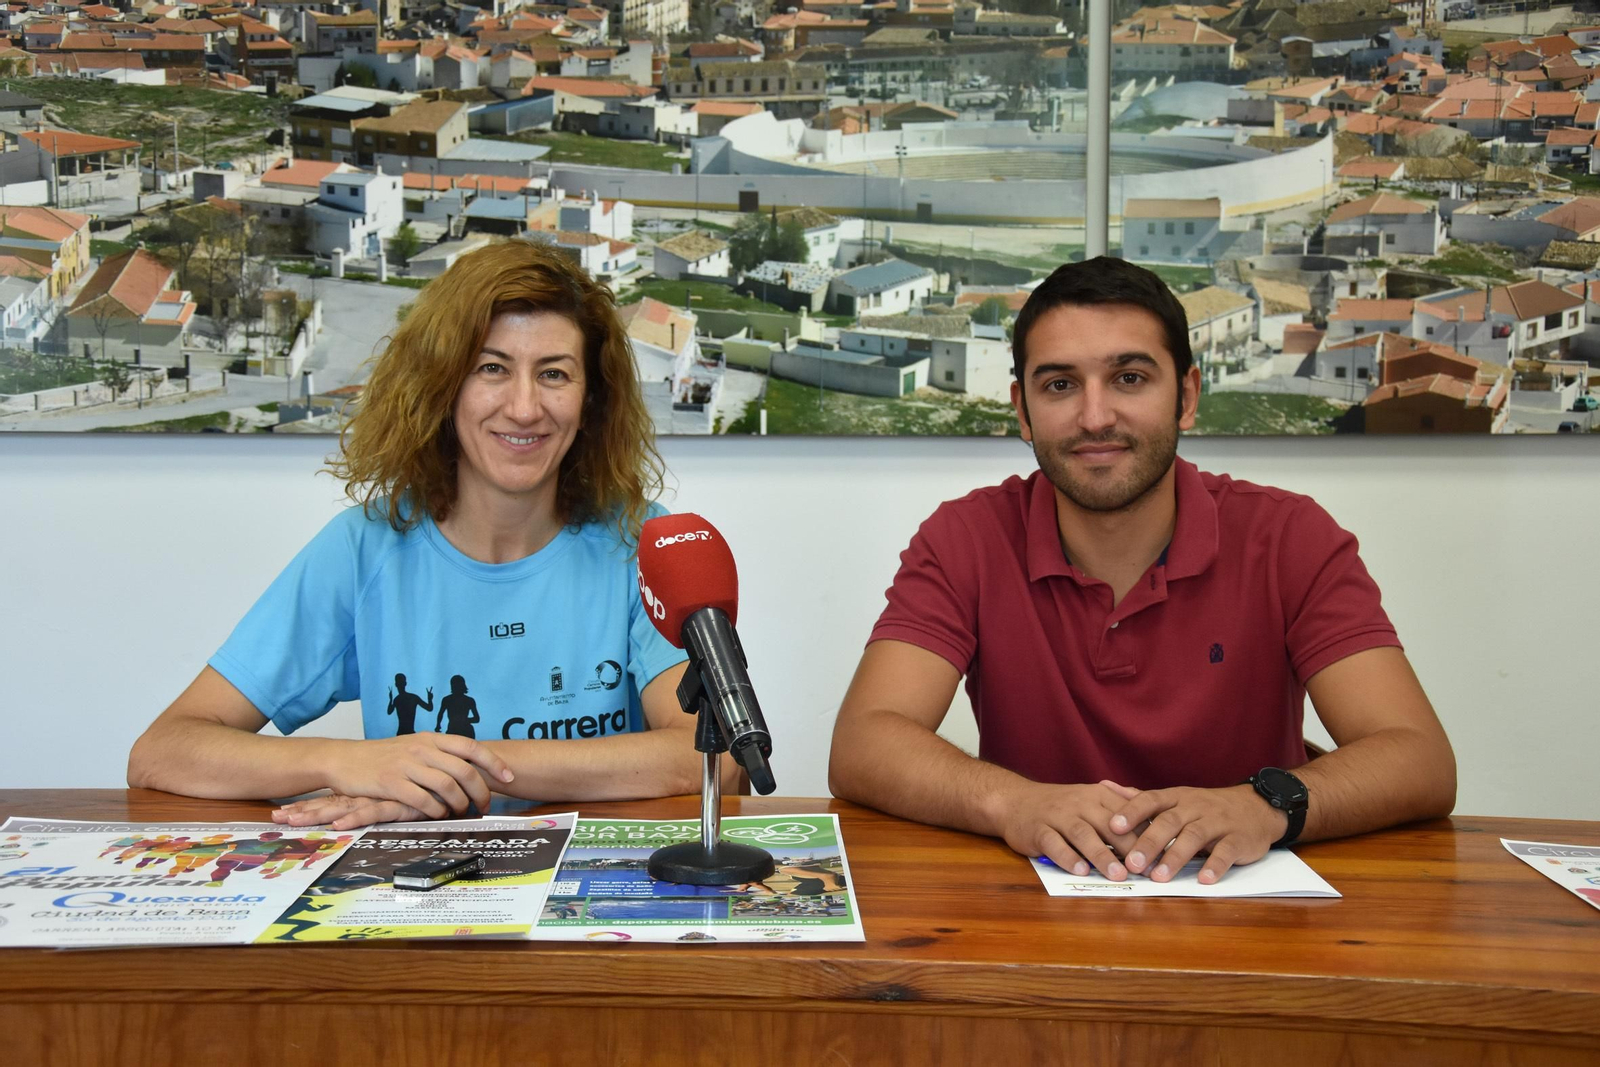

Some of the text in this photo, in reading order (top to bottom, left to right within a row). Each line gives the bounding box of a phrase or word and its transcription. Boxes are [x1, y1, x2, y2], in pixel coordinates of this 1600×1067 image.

[502, 708, 627, 740] Carrera
[19, 824, 131, 833] Circuito
[3, 866, 78, 876] 21
[52, 891, 267, 908] Quesada
[31, 910, 138, 918] Ciudad
[185, 908, 251, 916] Baza
